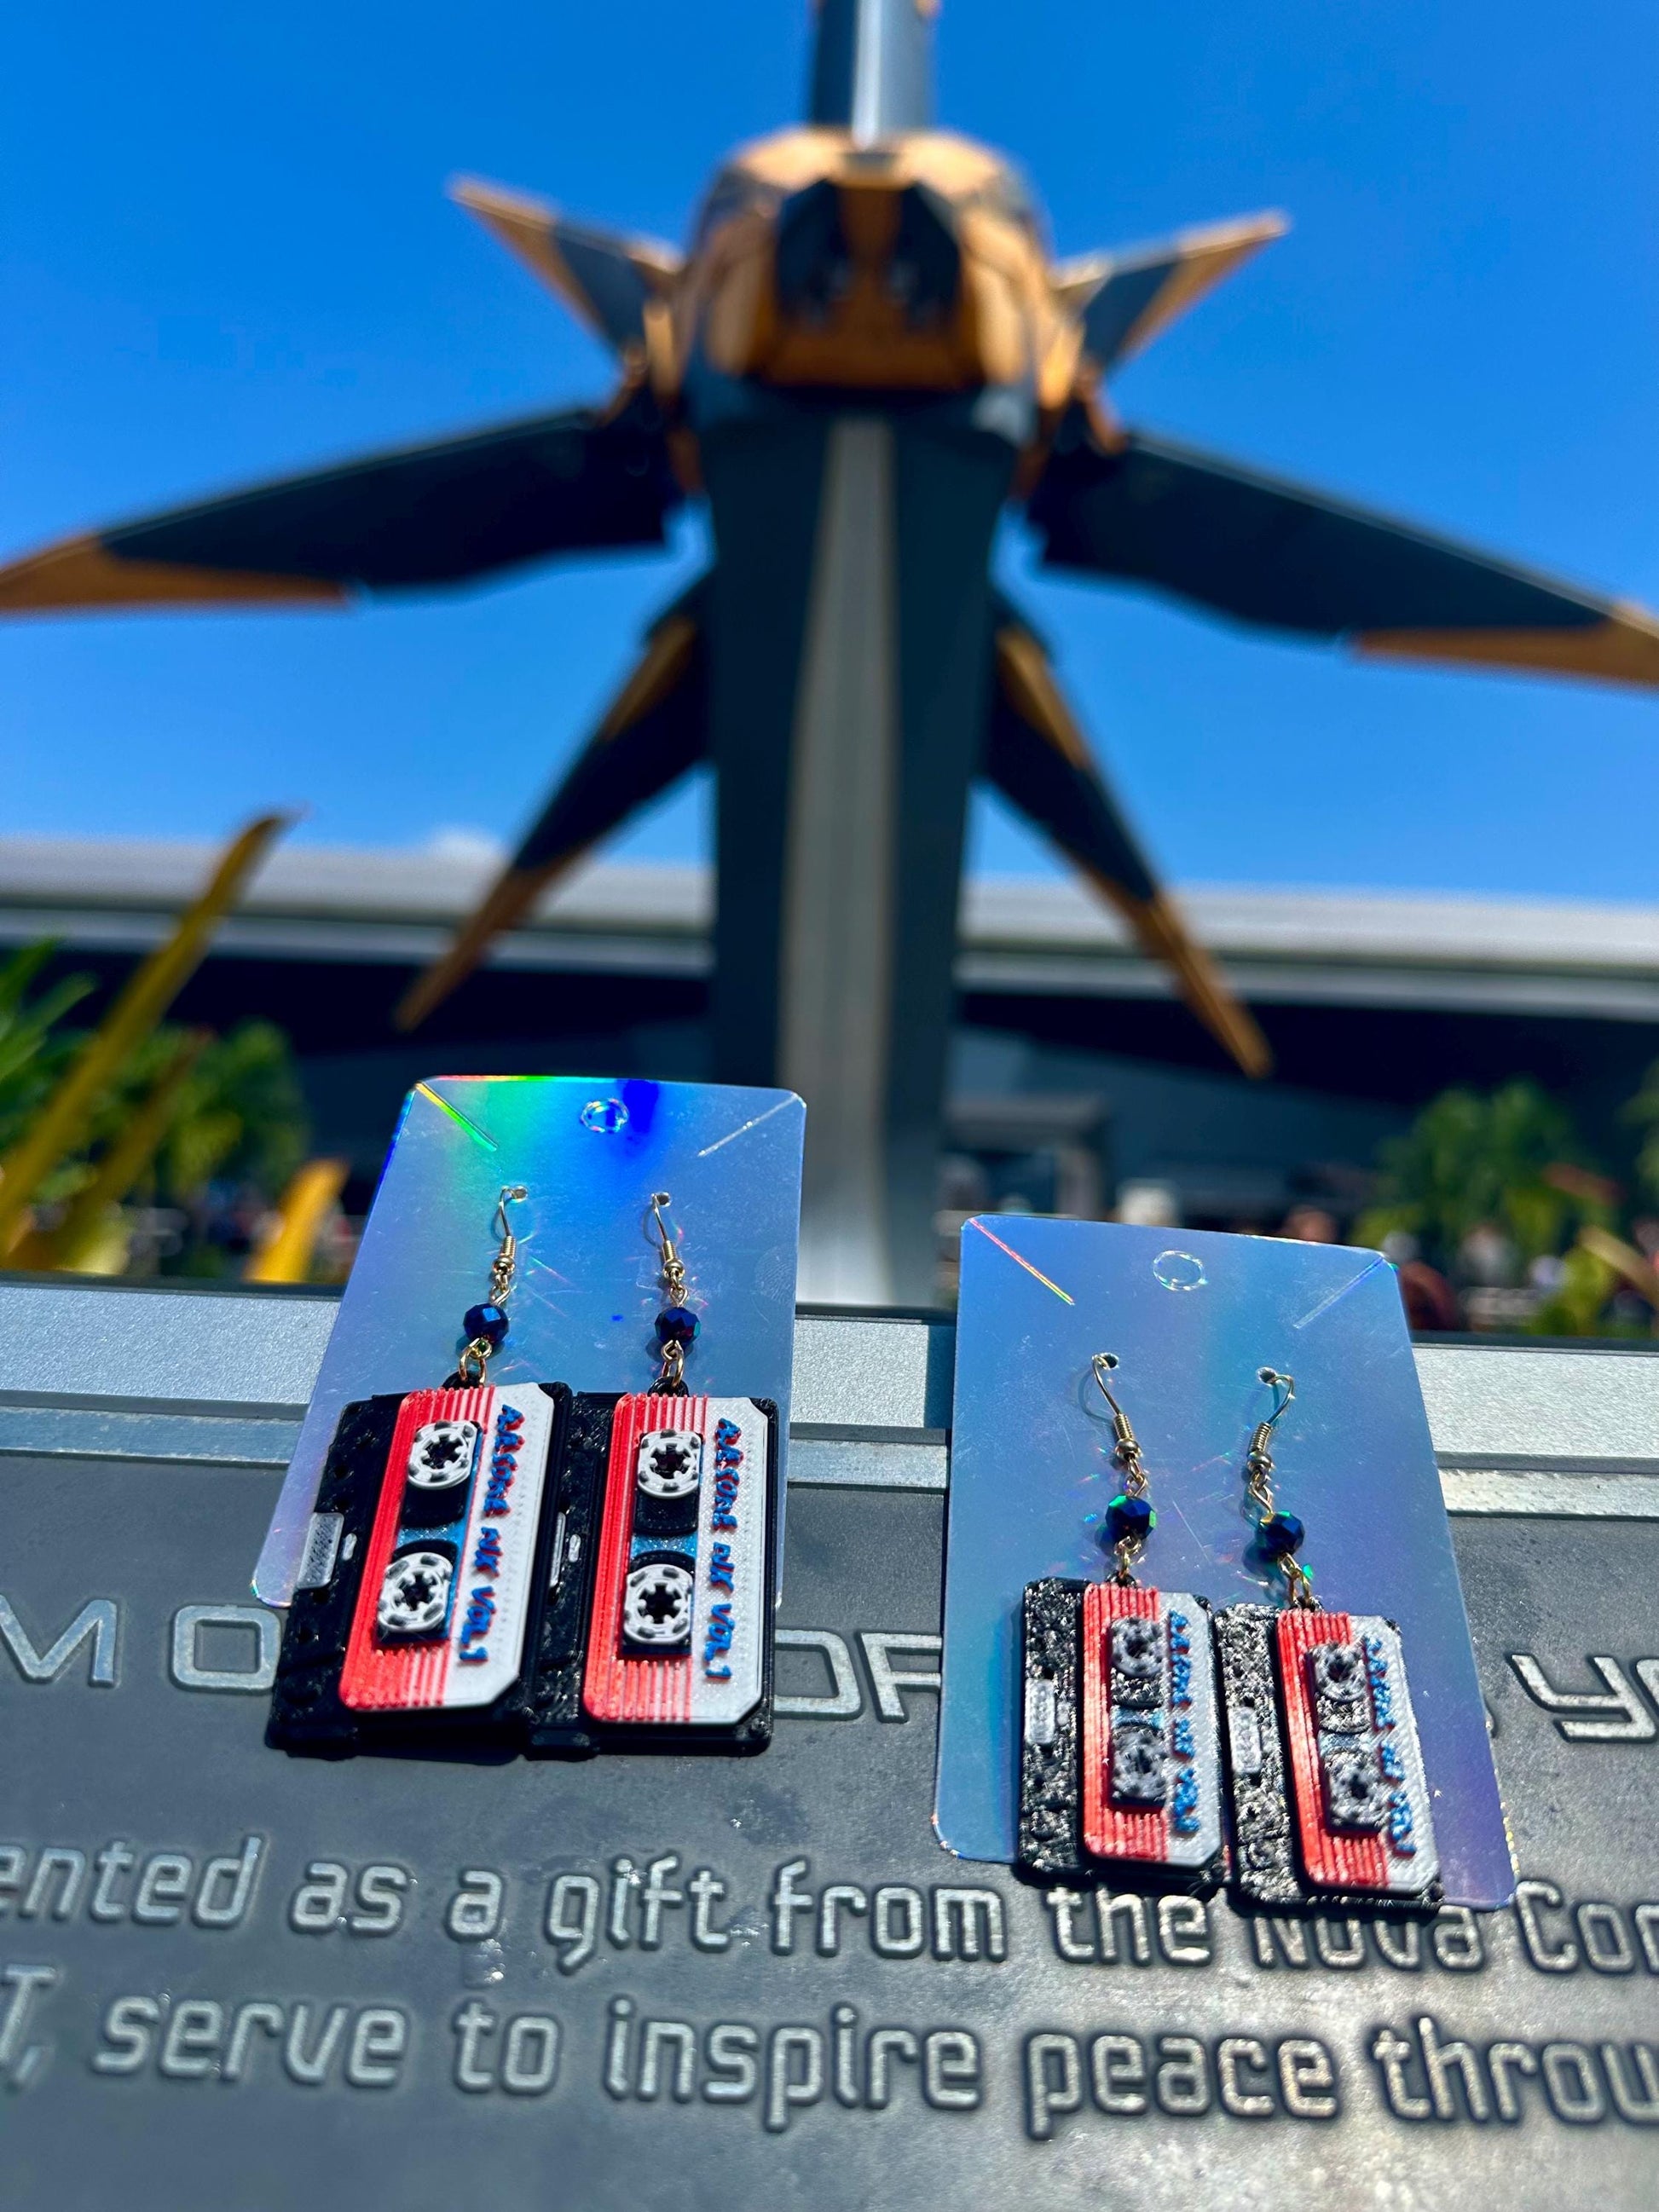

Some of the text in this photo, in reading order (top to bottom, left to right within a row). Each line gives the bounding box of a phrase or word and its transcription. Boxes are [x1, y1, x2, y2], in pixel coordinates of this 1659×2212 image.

[292, 1862, 409, 1935] as
[448, 1870, 505, 1942] a
[546, 1850, 731, 1974] gift
[770, 1858, 1009, 1961] from
[1046, 1882, 1214, 1962] the
[92, 1993, 409, 2088] serve
[454, 2000, 561, 2094] to
[604, 1996, 982, 2131] inspire
[1026, 2031, 1341, 2140] peace
